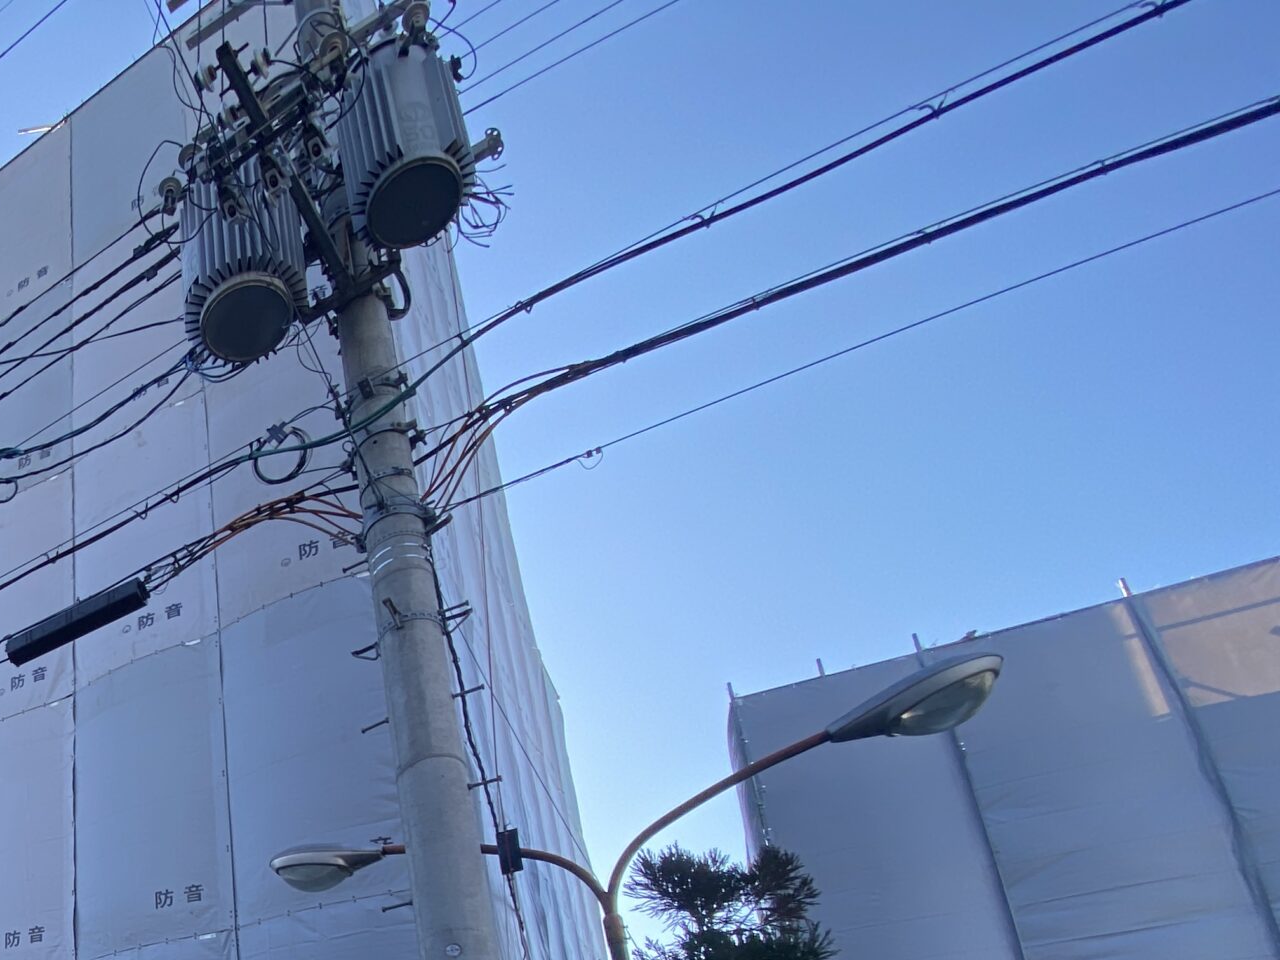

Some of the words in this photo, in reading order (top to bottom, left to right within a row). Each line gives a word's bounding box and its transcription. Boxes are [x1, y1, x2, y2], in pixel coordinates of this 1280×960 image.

[299, 531, 355, 560] 防音
[138, 603, 183, 630] 防音
[10, 667, 48, 692] 防音
[155, 884, 204, 909] 防音
[5, 925, 45, 949] 防音
